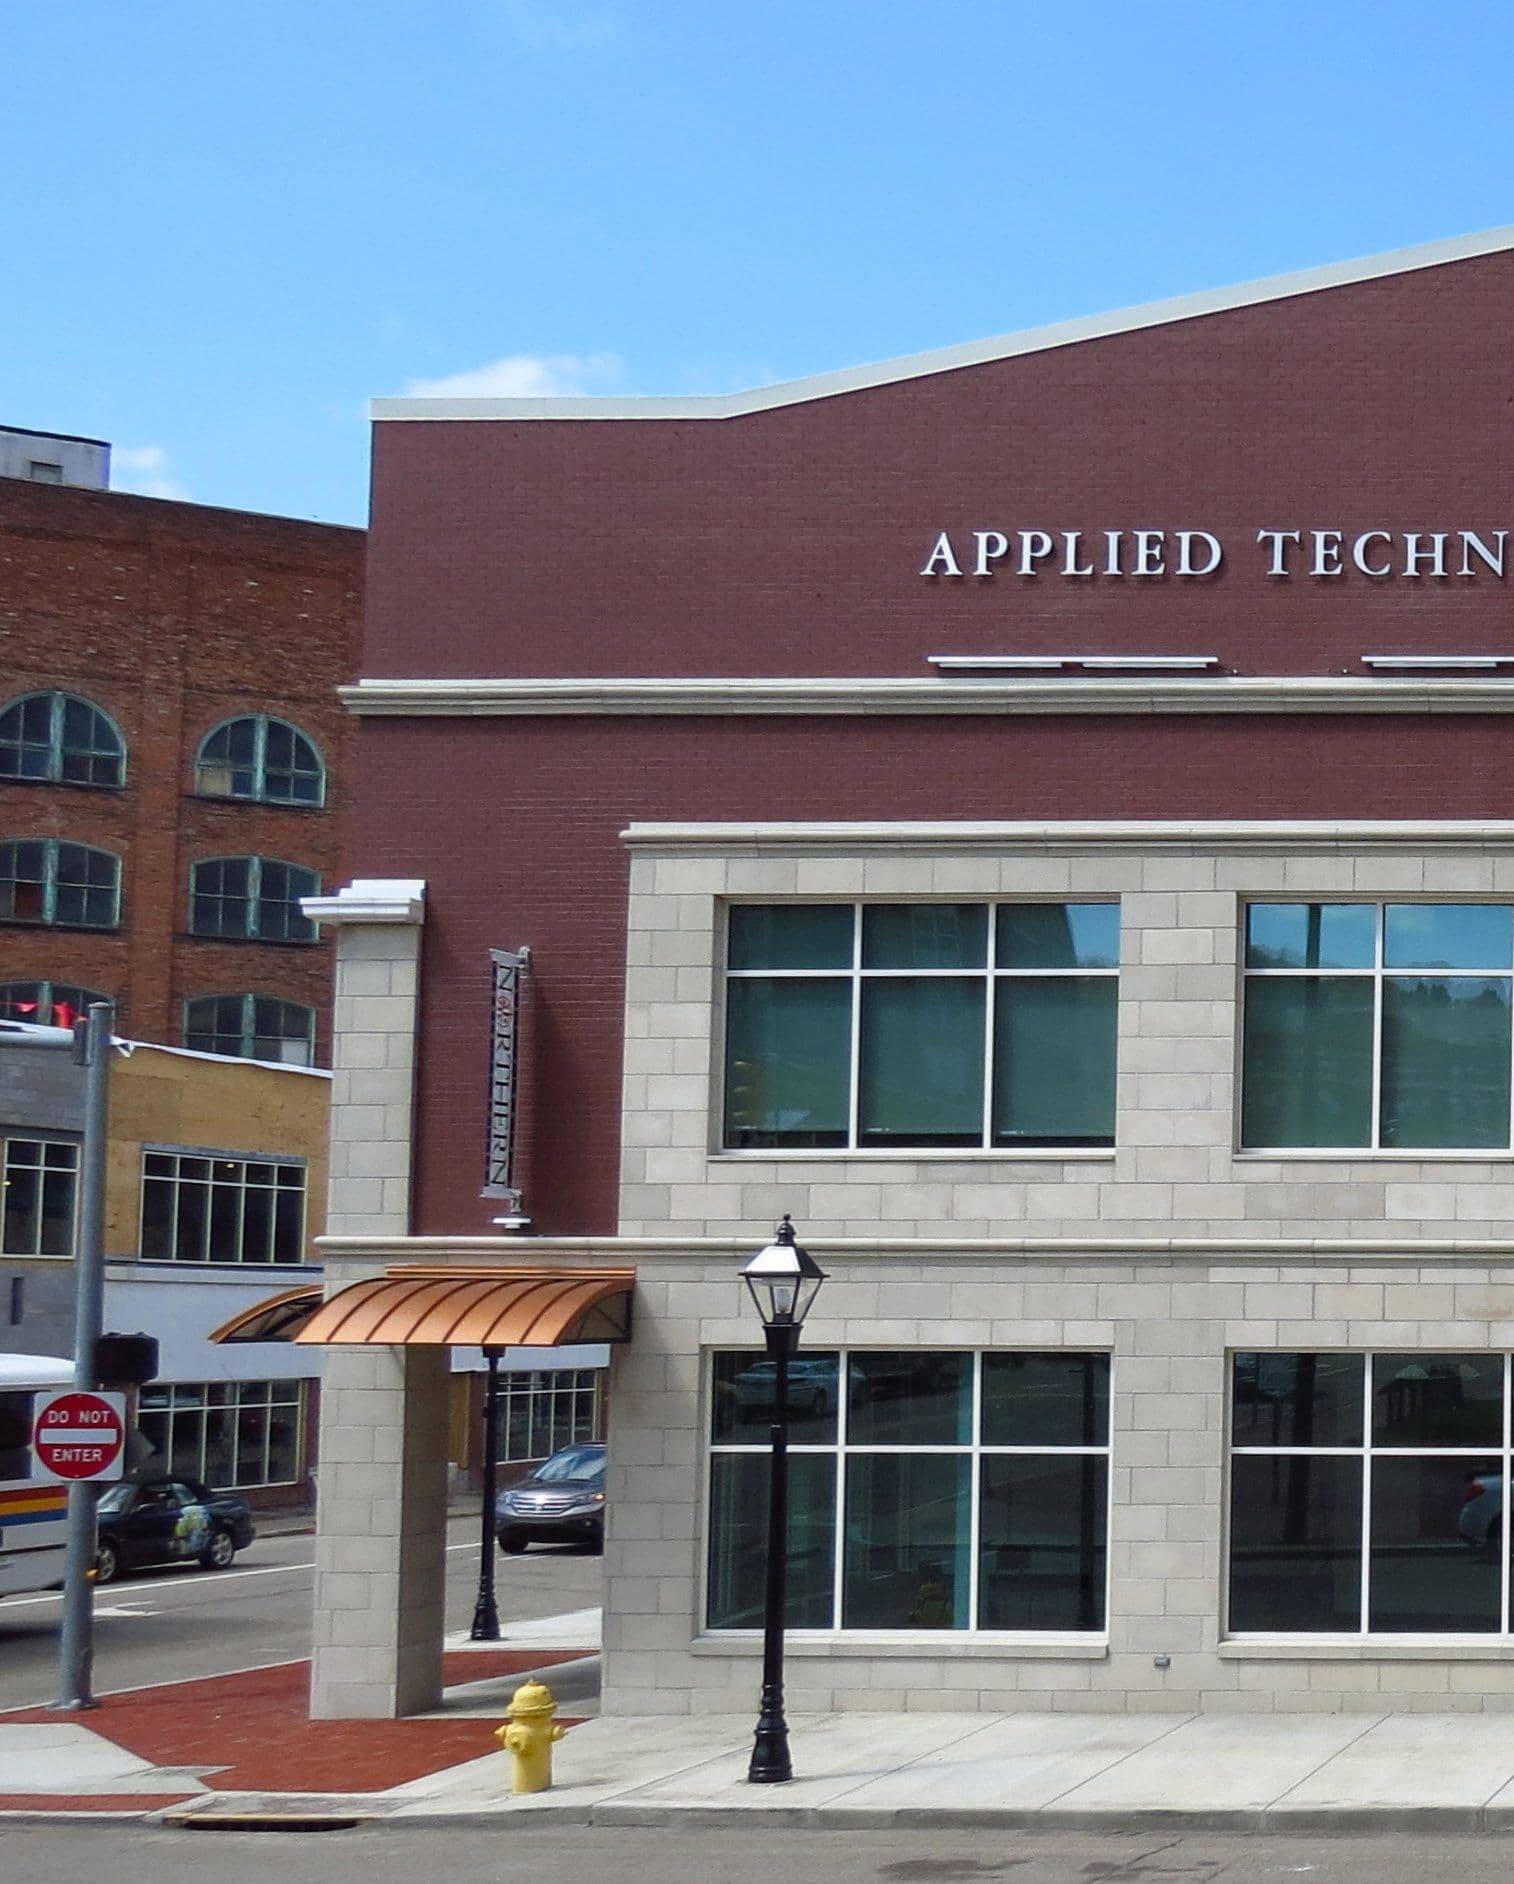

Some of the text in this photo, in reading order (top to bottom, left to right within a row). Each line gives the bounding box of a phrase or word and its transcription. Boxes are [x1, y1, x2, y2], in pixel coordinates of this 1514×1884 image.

[919, 530, 1223, 576] APPLIED
[48, 1410, 111, 1424] DO NOT
[52, 1448, 102, 1462] ENTER
